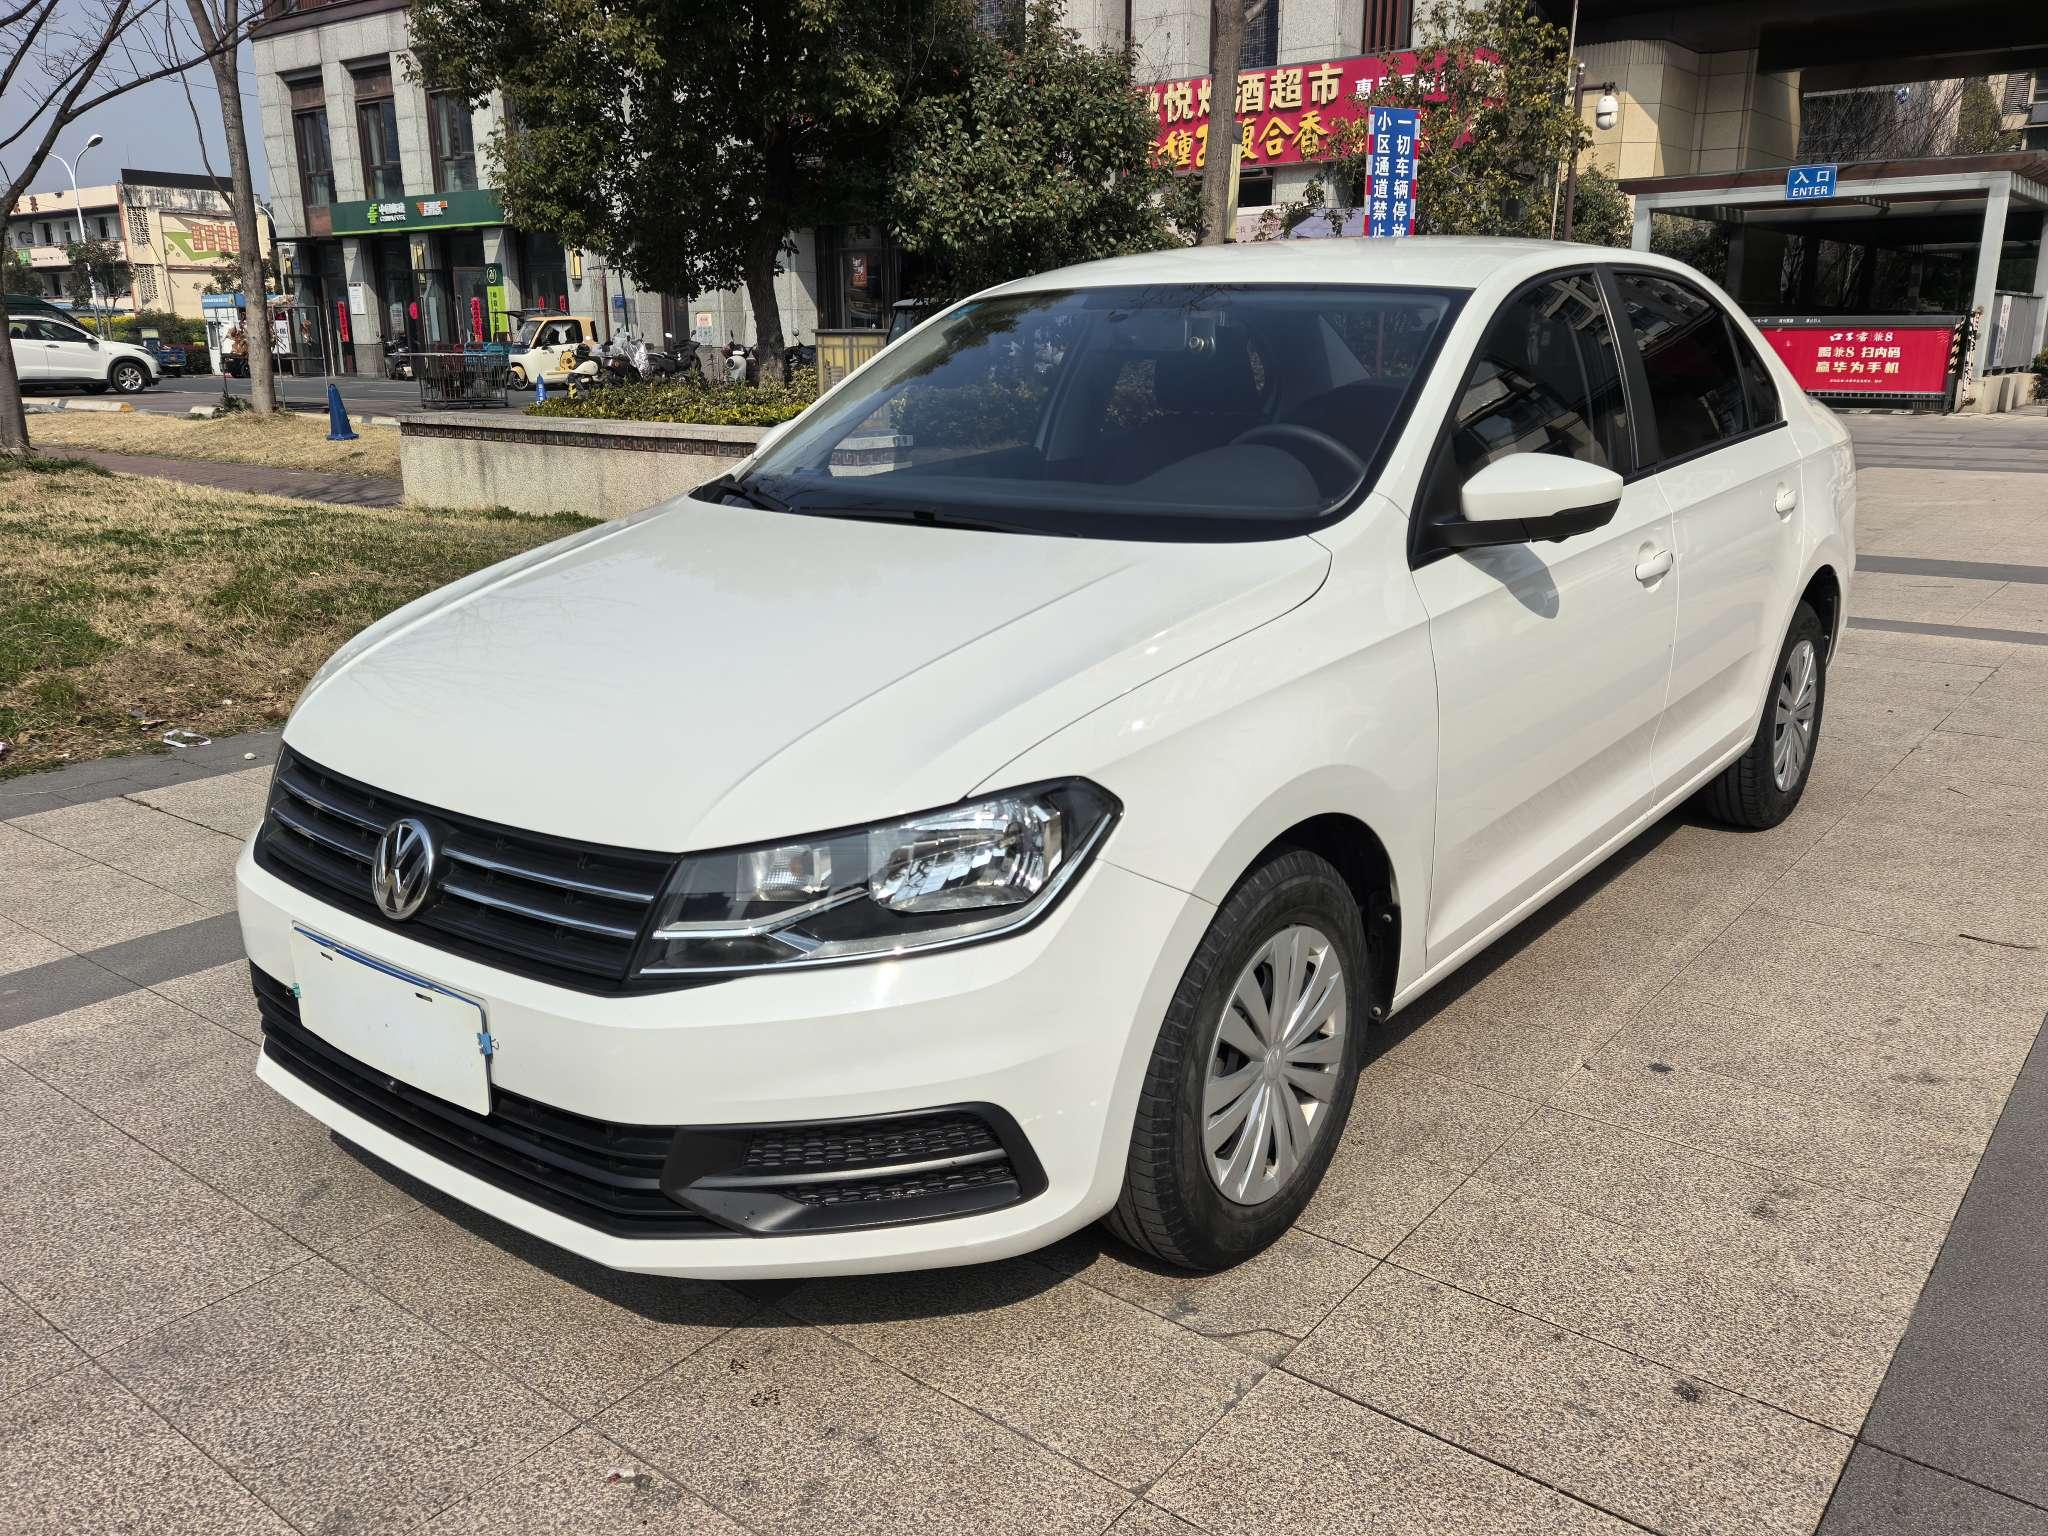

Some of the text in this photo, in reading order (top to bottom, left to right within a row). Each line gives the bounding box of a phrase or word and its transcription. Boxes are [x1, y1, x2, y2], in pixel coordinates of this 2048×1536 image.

[1373, 111, 1392, 238] 小区通道禁止
[1392, 119, 1412, 237] 一切车辆停放
[1792, 186, 1828, 197] ENTER
[1795, 171, 1830, 184] 入口
